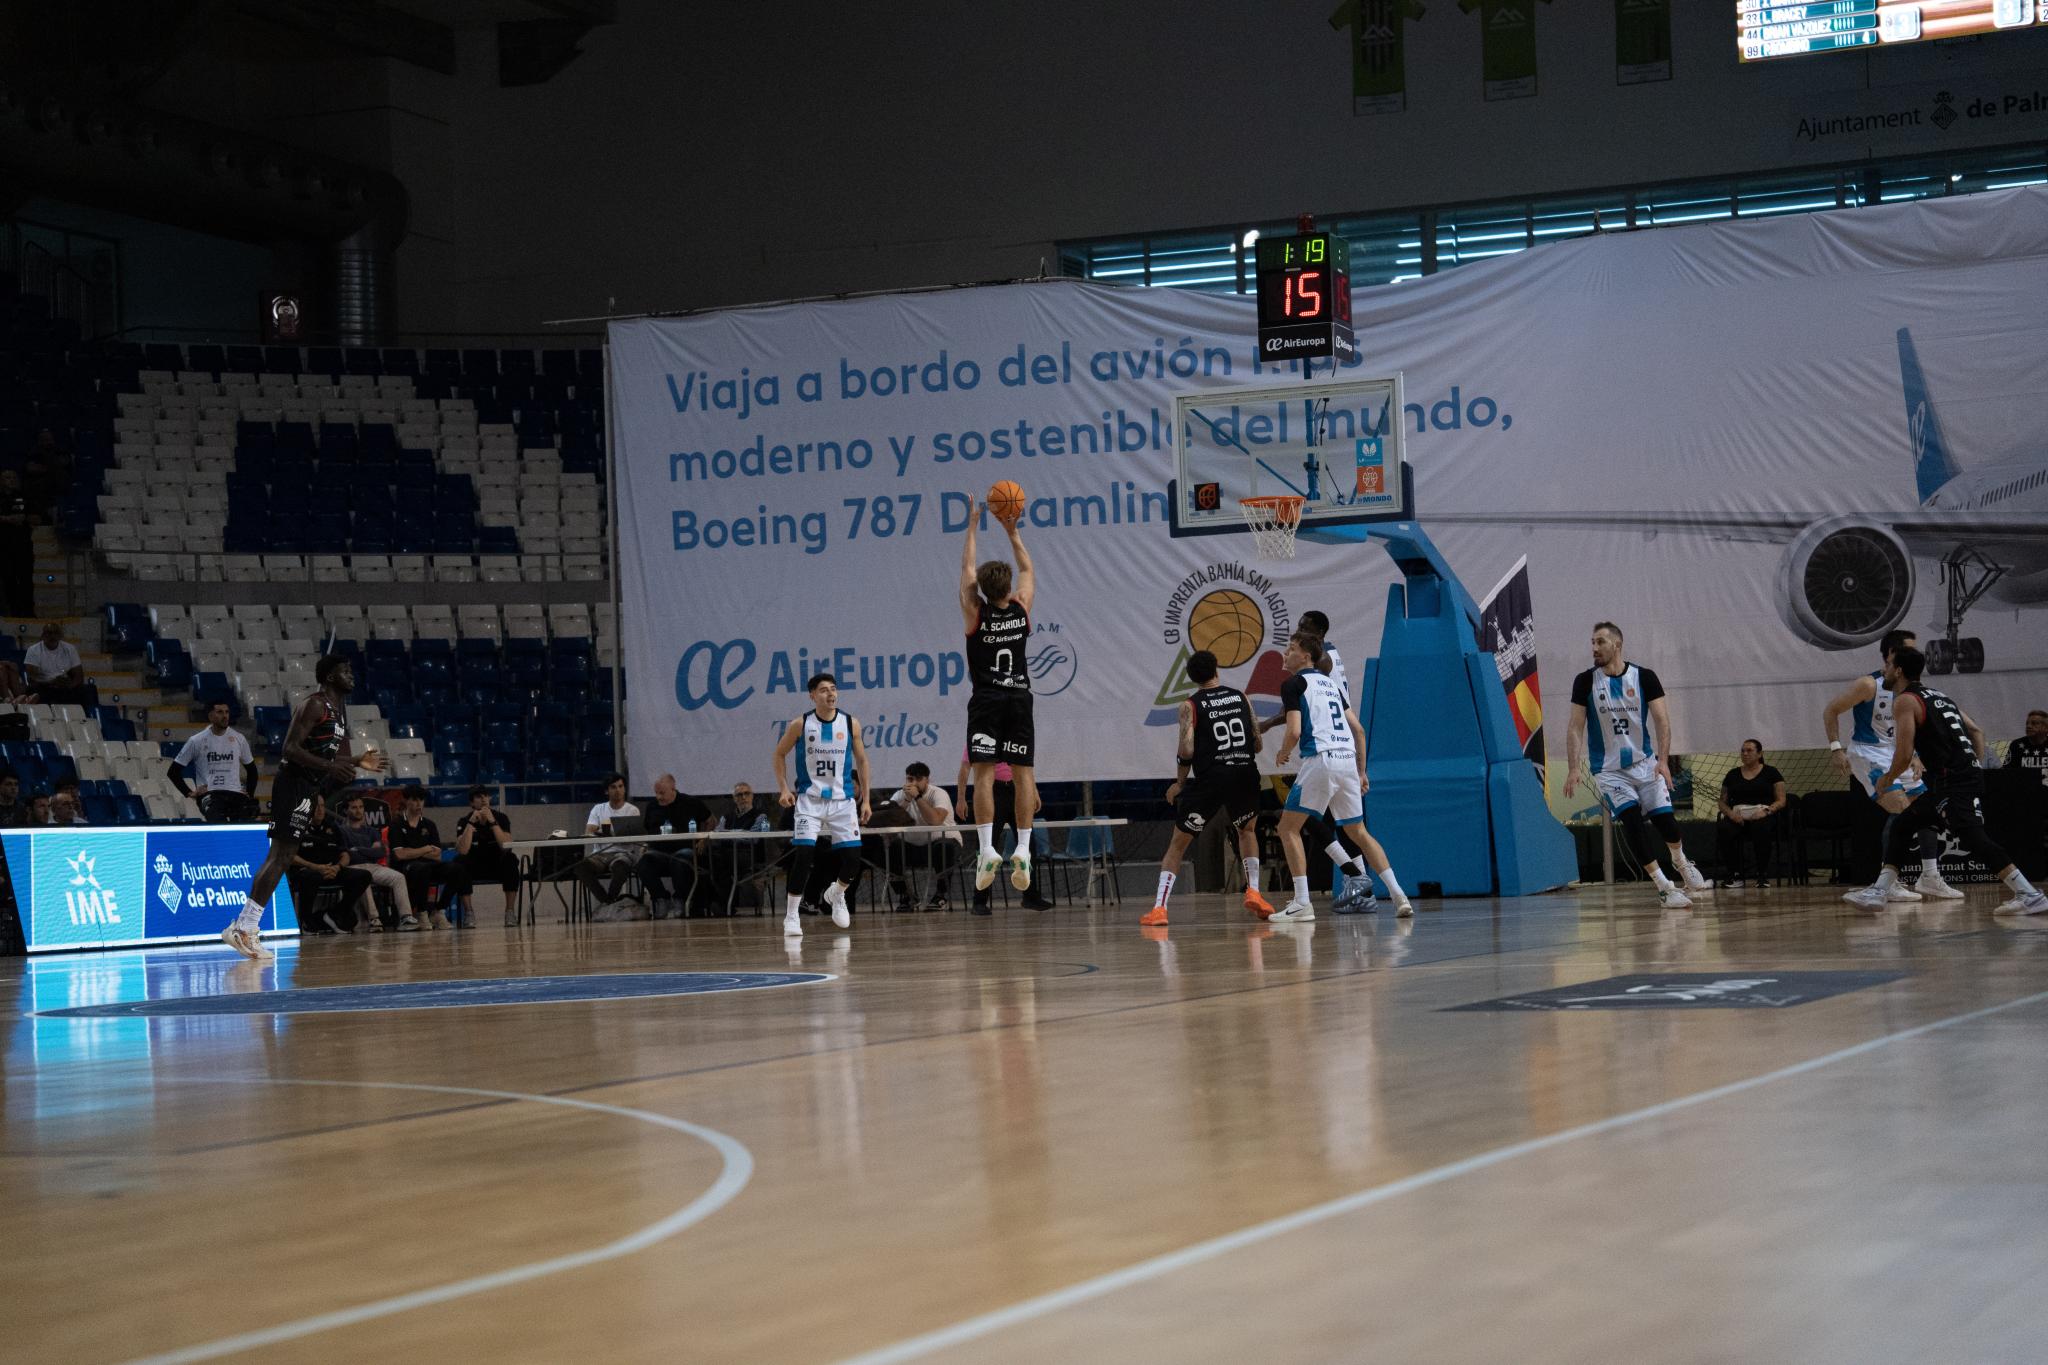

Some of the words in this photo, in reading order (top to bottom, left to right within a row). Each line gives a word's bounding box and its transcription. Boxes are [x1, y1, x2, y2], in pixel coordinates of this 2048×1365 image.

[1746, 13, 1757, 24] 33
[1746, 29, 1758, 39] 44
[1747, 46, 1759, 57] 99
[1796, 107, 1922, 142] Ajuntament
[1966, 97, 1996, 119] de
[1285, 239, 1325, 264] 1:19
[1284, 272, 1320, 318] 15
[1284, 337, 1326, 349] AirEuropa
[666, 367, 780, 420] Viaja
[796, 371, 822, 402] a
[840, 350, 981, 399] bordo
[998, 341, 1071, 387] del
[1090, 336, 1232, 382] avión
[669, 435, 873, 482] moderno
[889, 435, 915, 477] y
[934, 407, 1193, 464] sostenible
[1211, 400, 1288, 447] del
[1363, 495, 1392, 503] MONDO
[673, 505, 827, 555] Boeing
[843, 494, 922, 540] 787
[1207, 560, 1245, 583] BAHÍA
[1246, 569, 1273, 597] SAN
[1164, 570, 1208, 625] IMPRENTA
[980, 622, 989, 632] A.
[990, 617, 1027, 632] SCARIOLO
[996, 633, 1023, 643] AirEuropa
[1164, 626, 1181, 646] CB
[766, 647, 973, 696] AirEurop
[1210, 695, 1242, 707] BOMBINO
[1328, 701, 1344, 731] 2
[1612, 718, 1630, 736] 22
[1212, 717, 1246, 751] 99
[206, 750, 234, 763] fibwi
[816, 760, 836, 778] 24
[213, 775, 225, 786] 23
[182, 861, 251, 886] Ajuntament
[65, 889, 121, 926] IME
[188, 889, 204, 908] de
[208, 886, 247, 907] Palma
